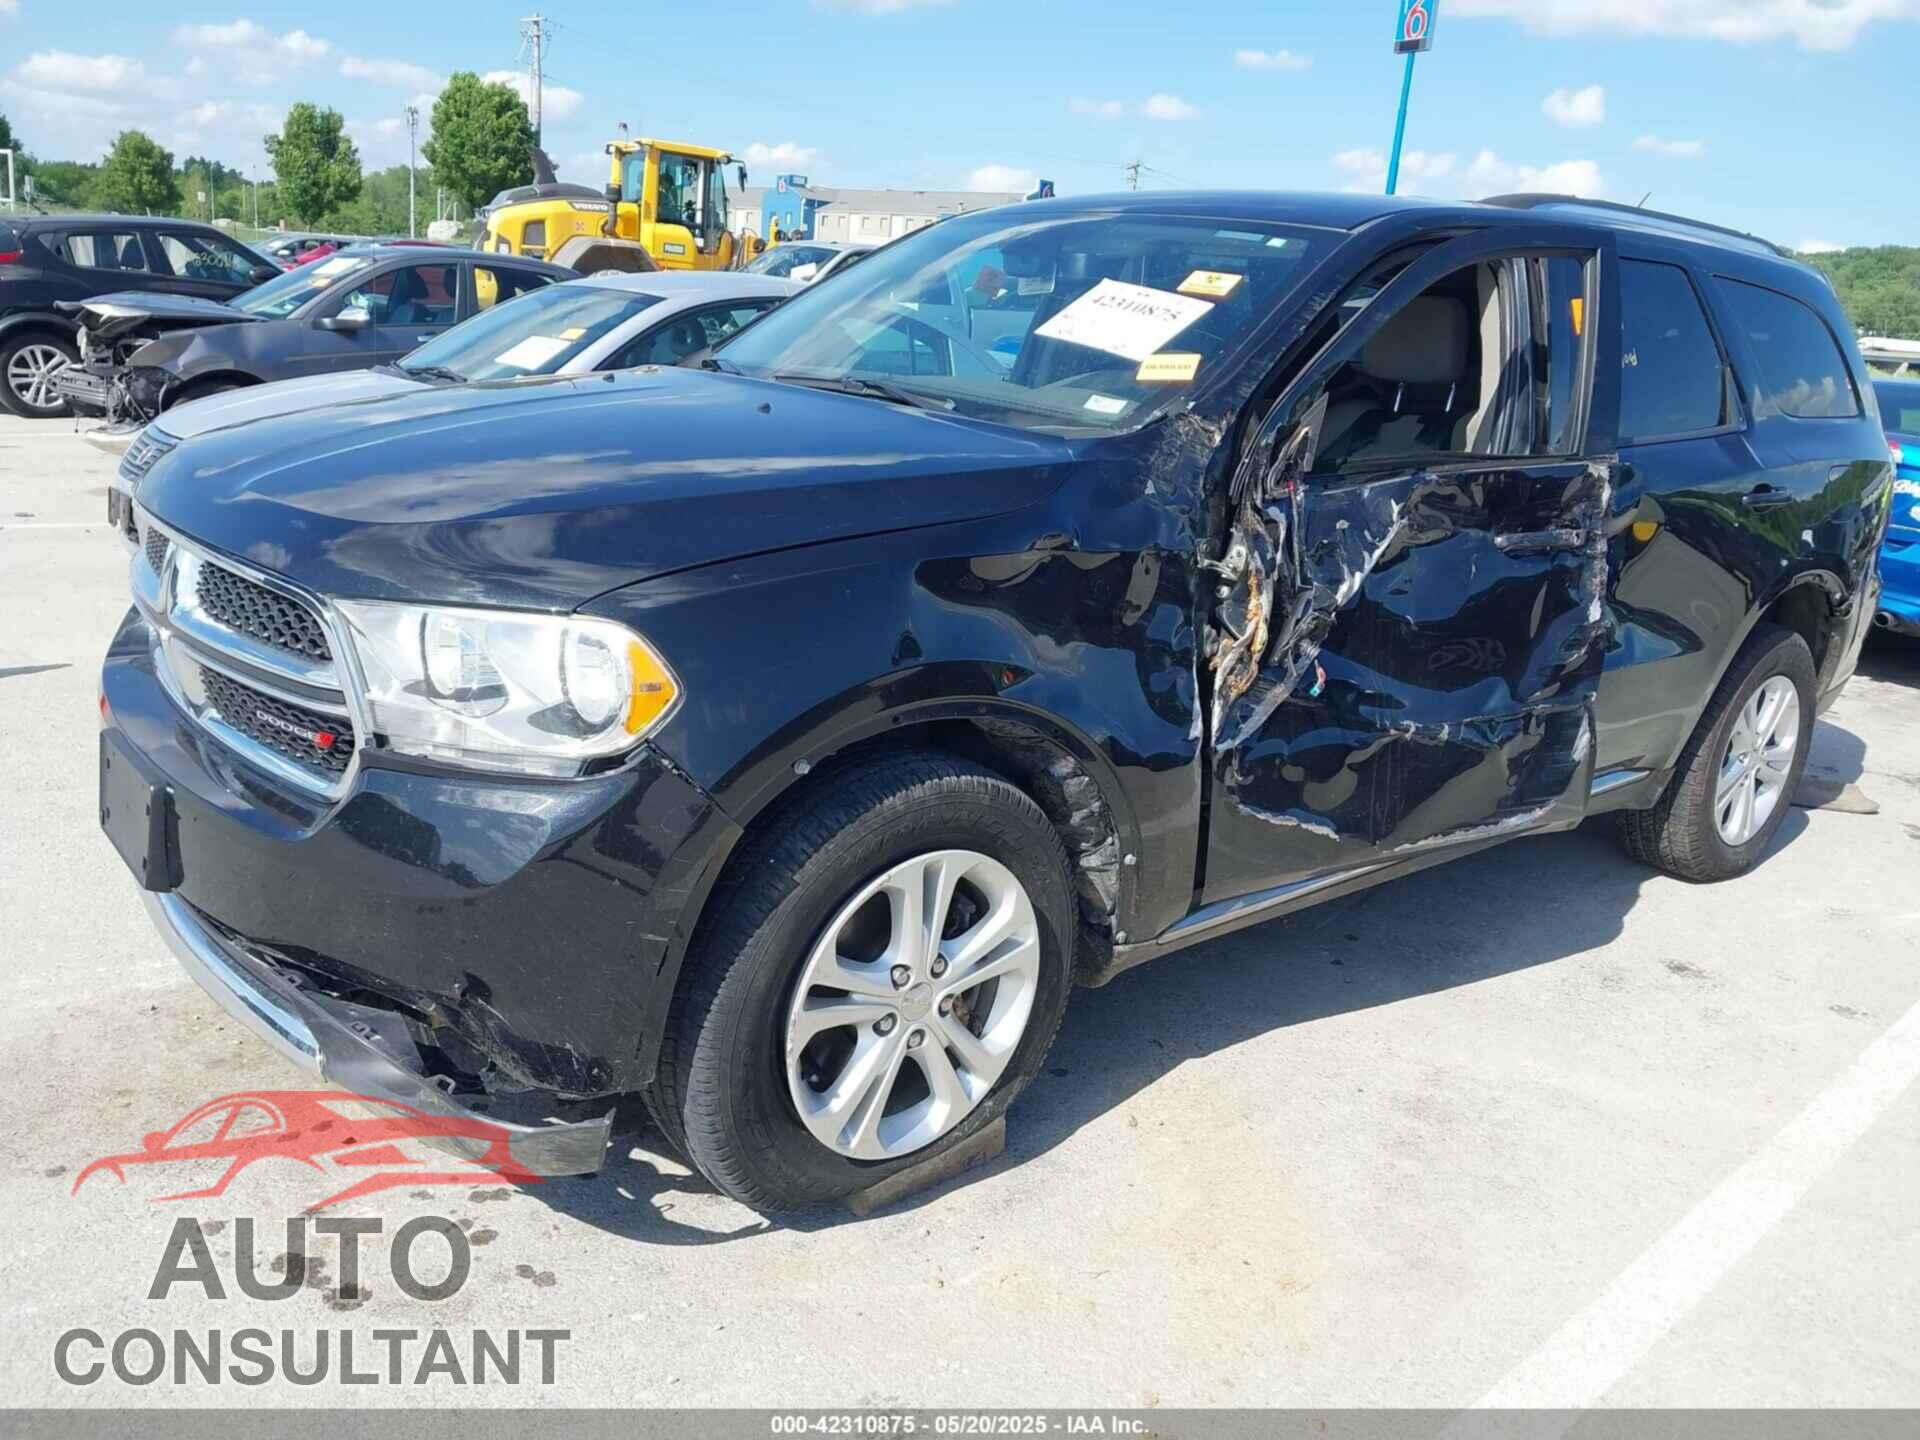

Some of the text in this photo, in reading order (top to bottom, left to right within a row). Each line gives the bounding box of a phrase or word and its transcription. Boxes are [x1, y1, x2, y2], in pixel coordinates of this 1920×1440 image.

[1404, 0, 1427, 40] 6
[1092, 294, 1182, 322] 42310875
[256, 710, 320, 744] DODGE
